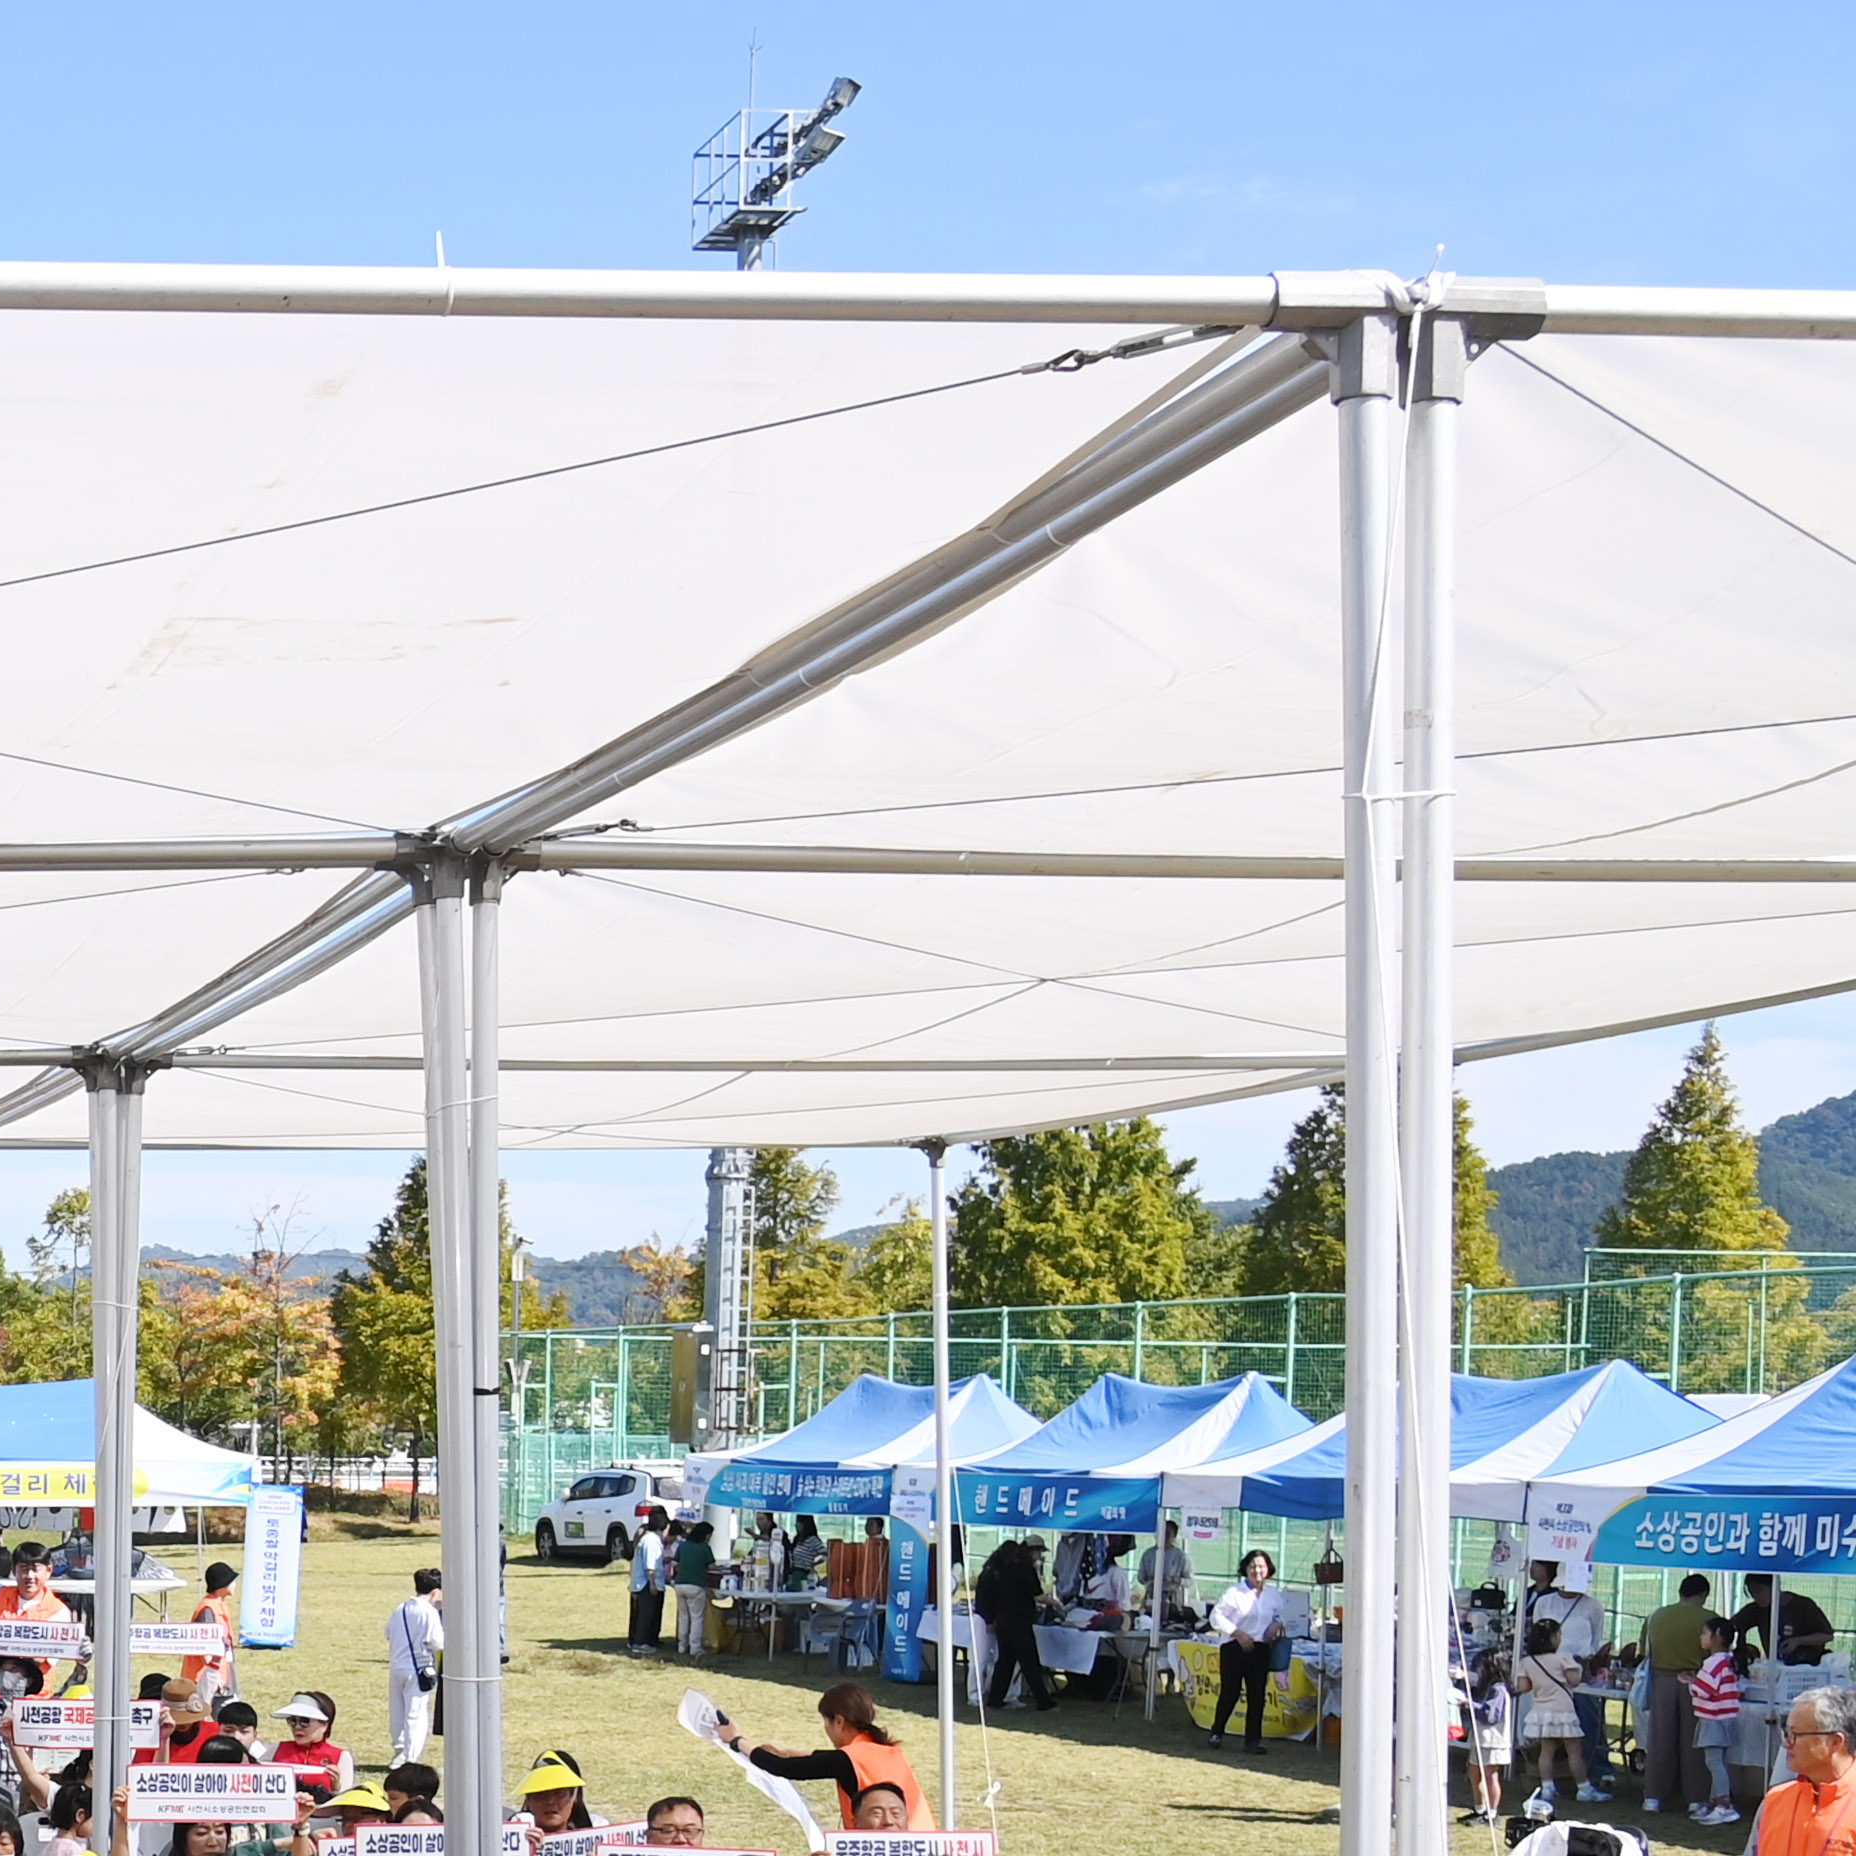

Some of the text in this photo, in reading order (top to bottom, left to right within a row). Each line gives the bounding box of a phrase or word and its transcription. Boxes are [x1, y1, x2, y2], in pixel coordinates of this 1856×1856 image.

[1635, 1510, 1750, 1555] 소상공인과
[1759, 1513, 1806, 1557] 함께
[14, 1626, 52, 1639] 복합도시
[47, 1627, 83, 1645] 사천시
[137, 1773, 286, 1793] 소상공인이 살아야 사천이 산다
